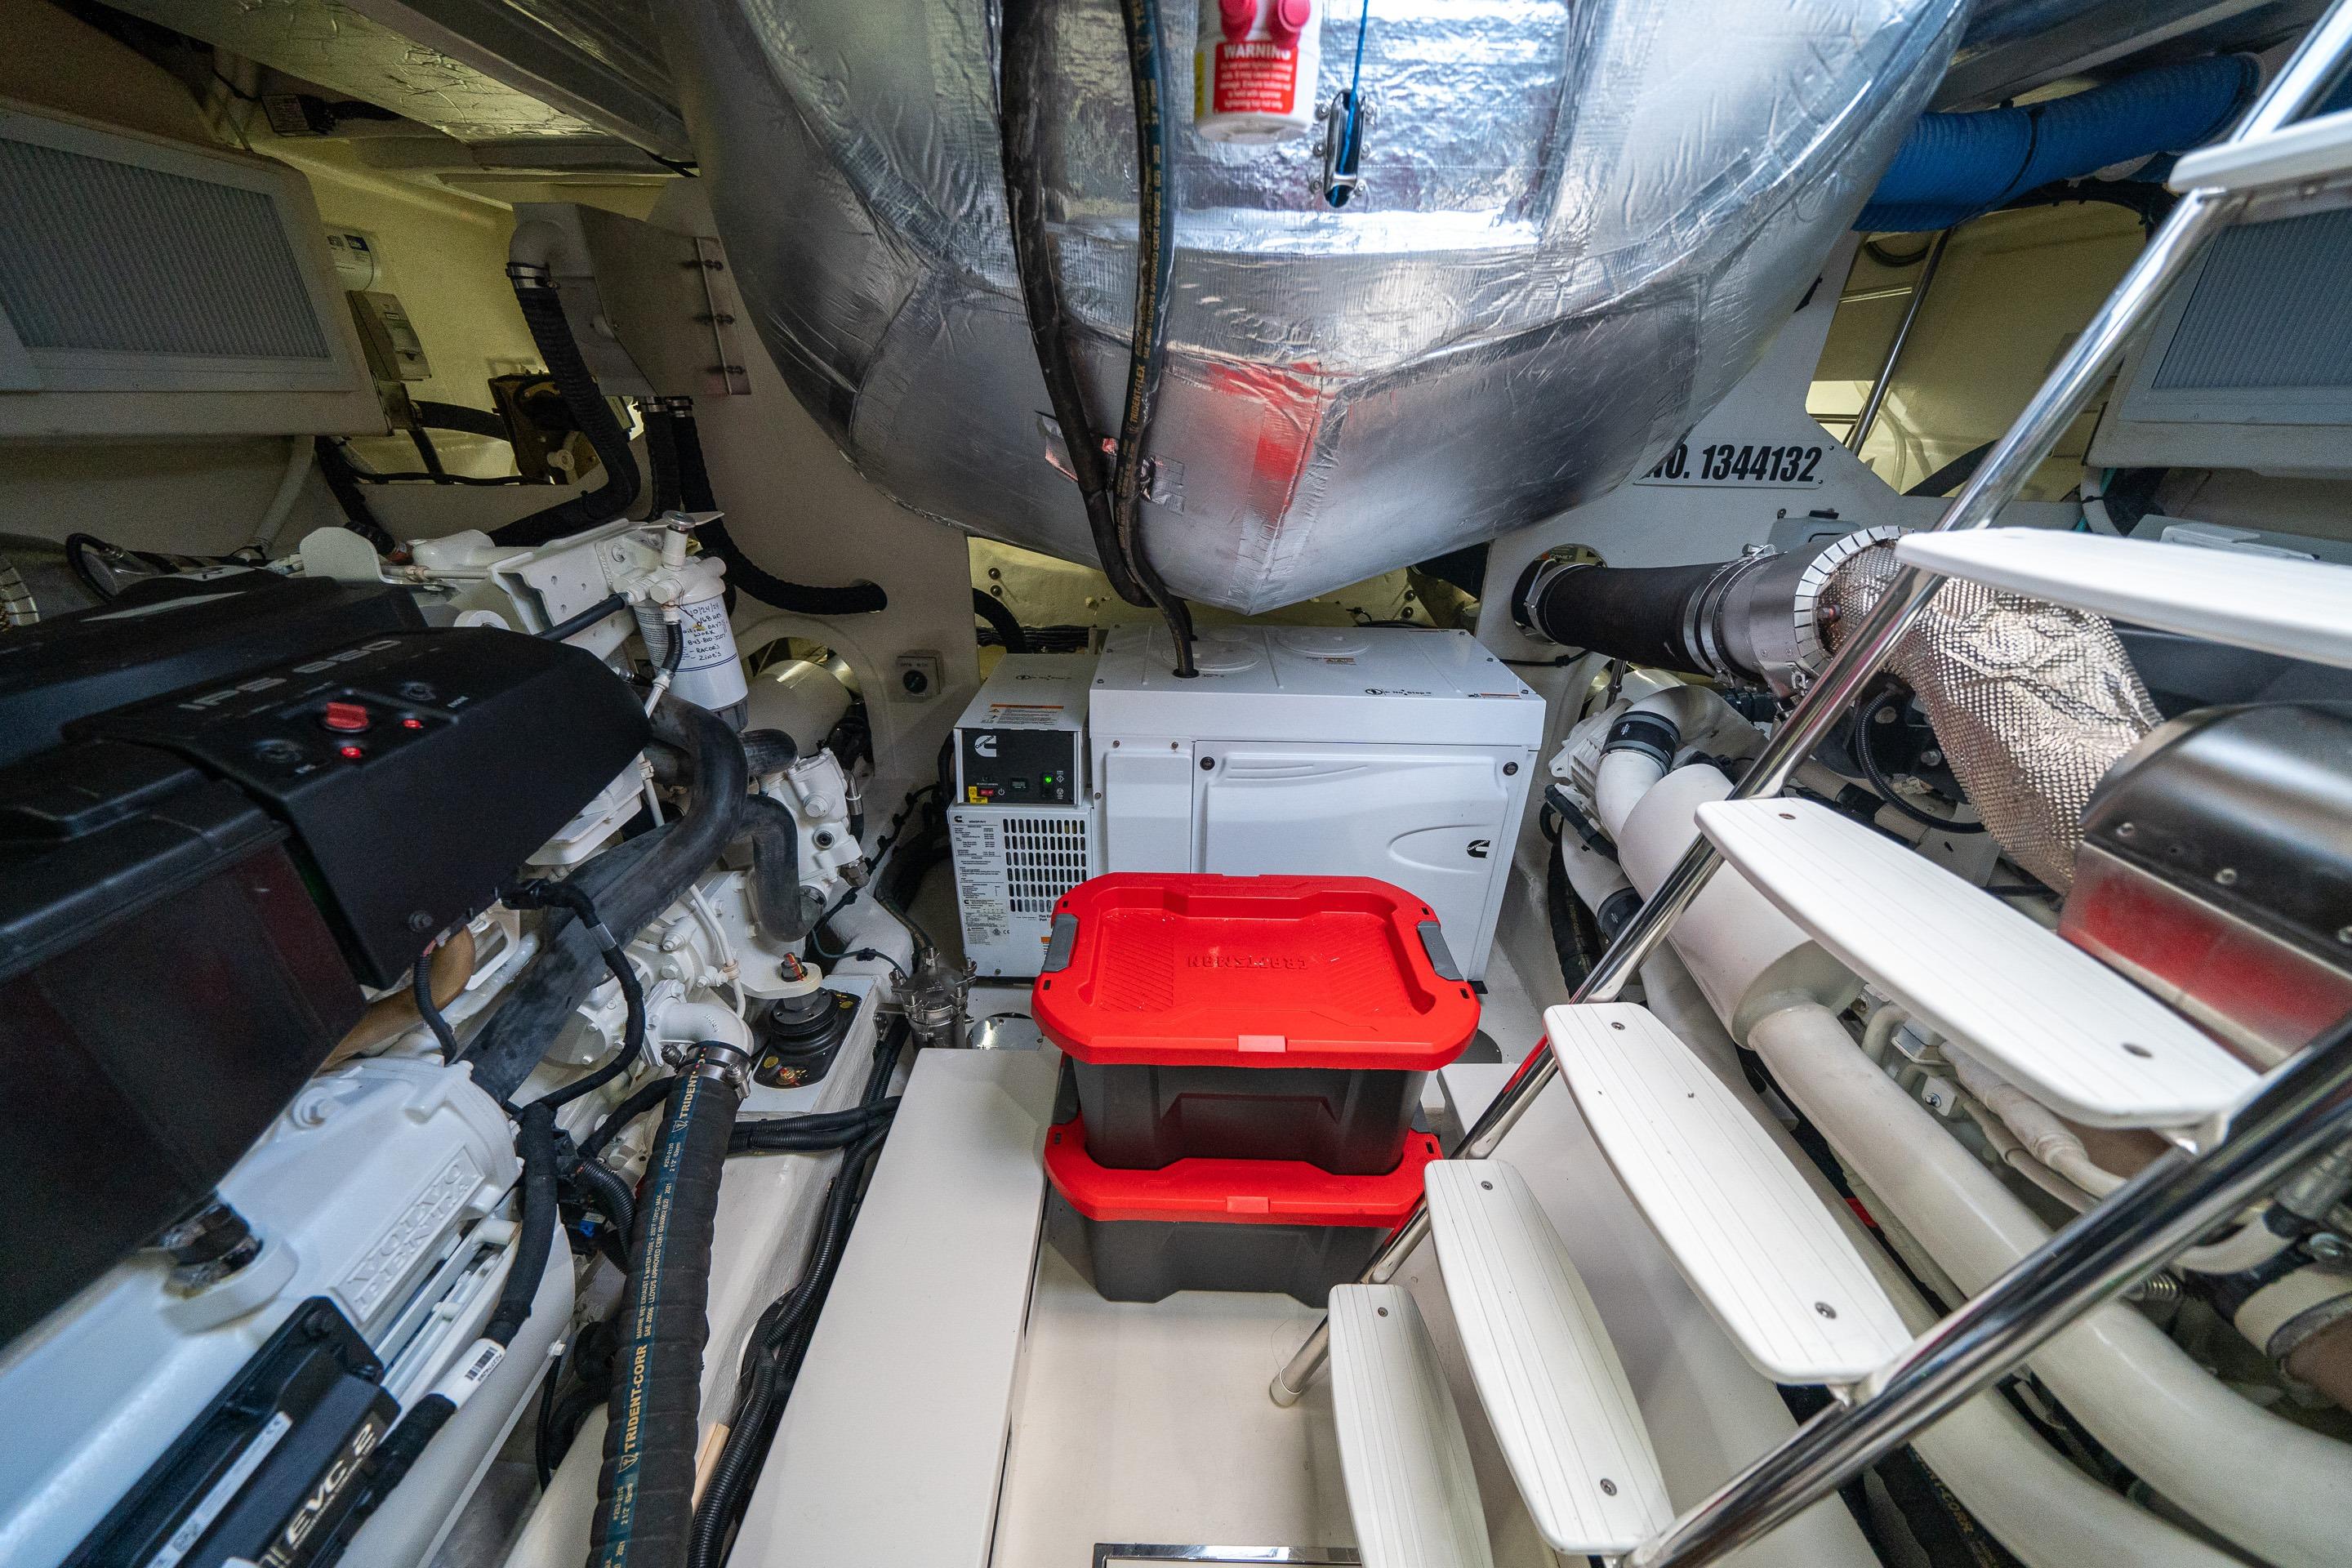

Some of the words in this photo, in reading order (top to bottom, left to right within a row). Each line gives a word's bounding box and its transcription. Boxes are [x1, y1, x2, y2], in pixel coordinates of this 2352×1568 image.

[1223, 42, 1291, 60] WARNING
[1700, 444, 1823, 482] 1344132
[178, 677, 287, 710] IPS
[346, 1157, 463, 1284] VOLVO
[354, 1174, 478, 1321] PENTA
[646, 1241, 654, 1256] HOSE
[655, 1233, 663, 1248] CERT
[644, 1257, 653, 1275] WATER
[651, 1249, 662, 1279] APPROVED
[640, 1281, 649, 1304] EXHAUST
[624, 1343, 648, 1453] TRIDENT-CORR
[287, 1459, 347, 1545] EVC
[353, 1423, 375, 1456] 2
